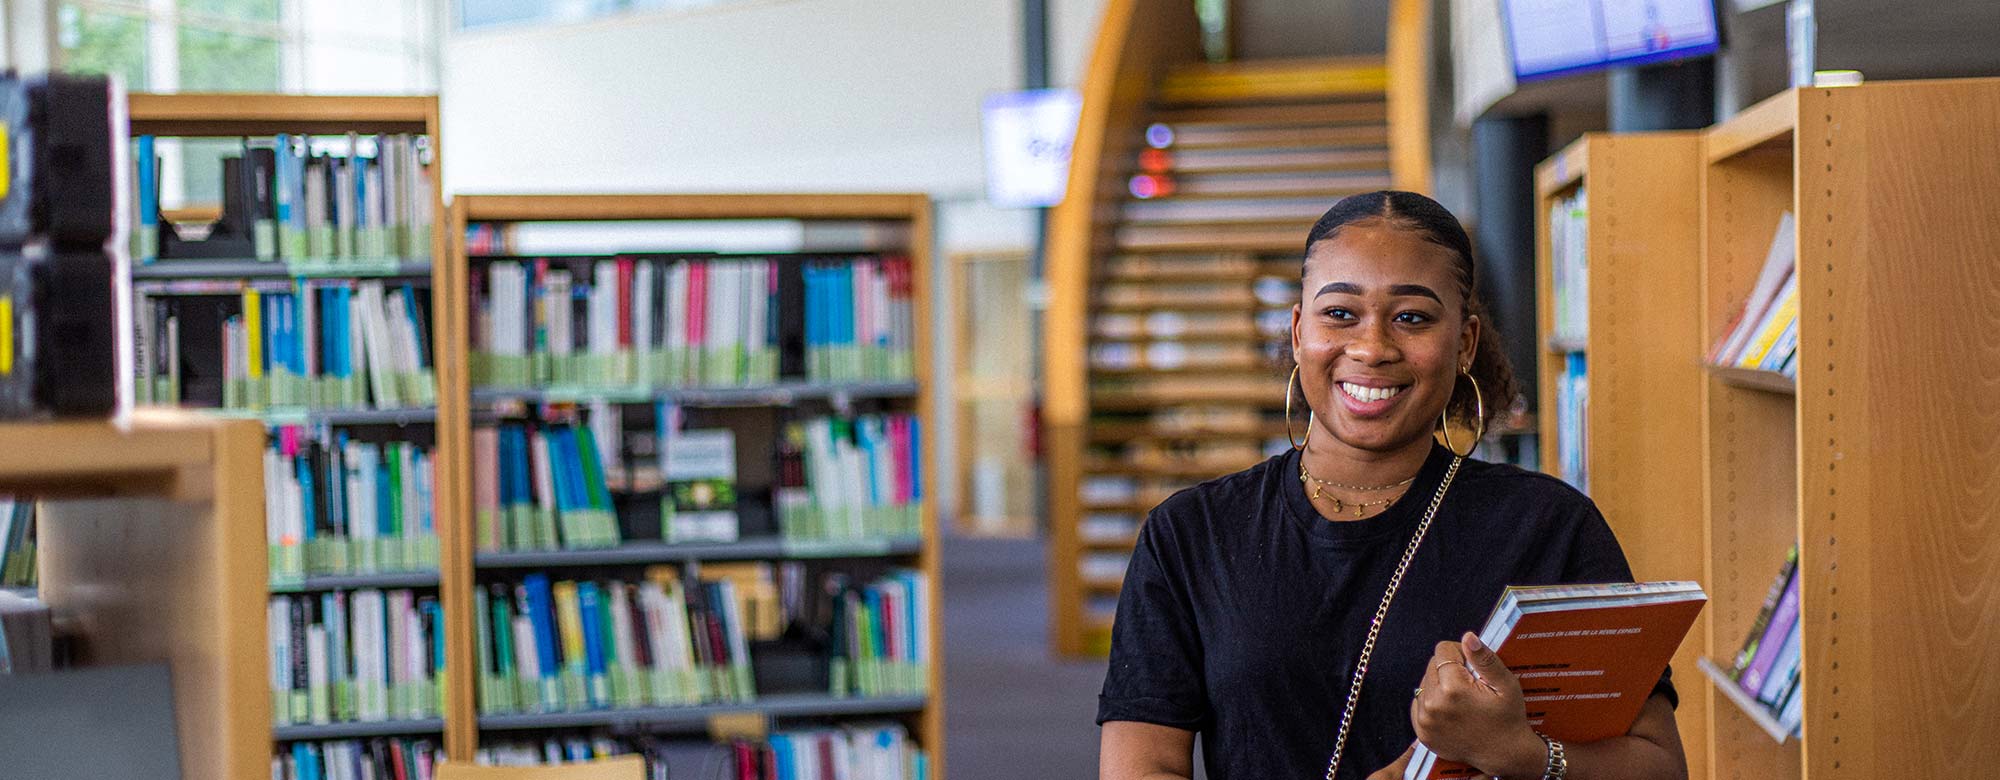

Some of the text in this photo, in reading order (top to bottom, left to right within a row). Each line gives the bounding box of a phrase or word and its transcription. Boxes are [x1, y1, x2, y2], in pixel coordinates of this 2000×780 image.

[1617, 627, 1642, 635] ESPACES
[1520, 671, 1558, 679] RESSOURCES
[1573, 692, 1610, 700] FORMATIONS
